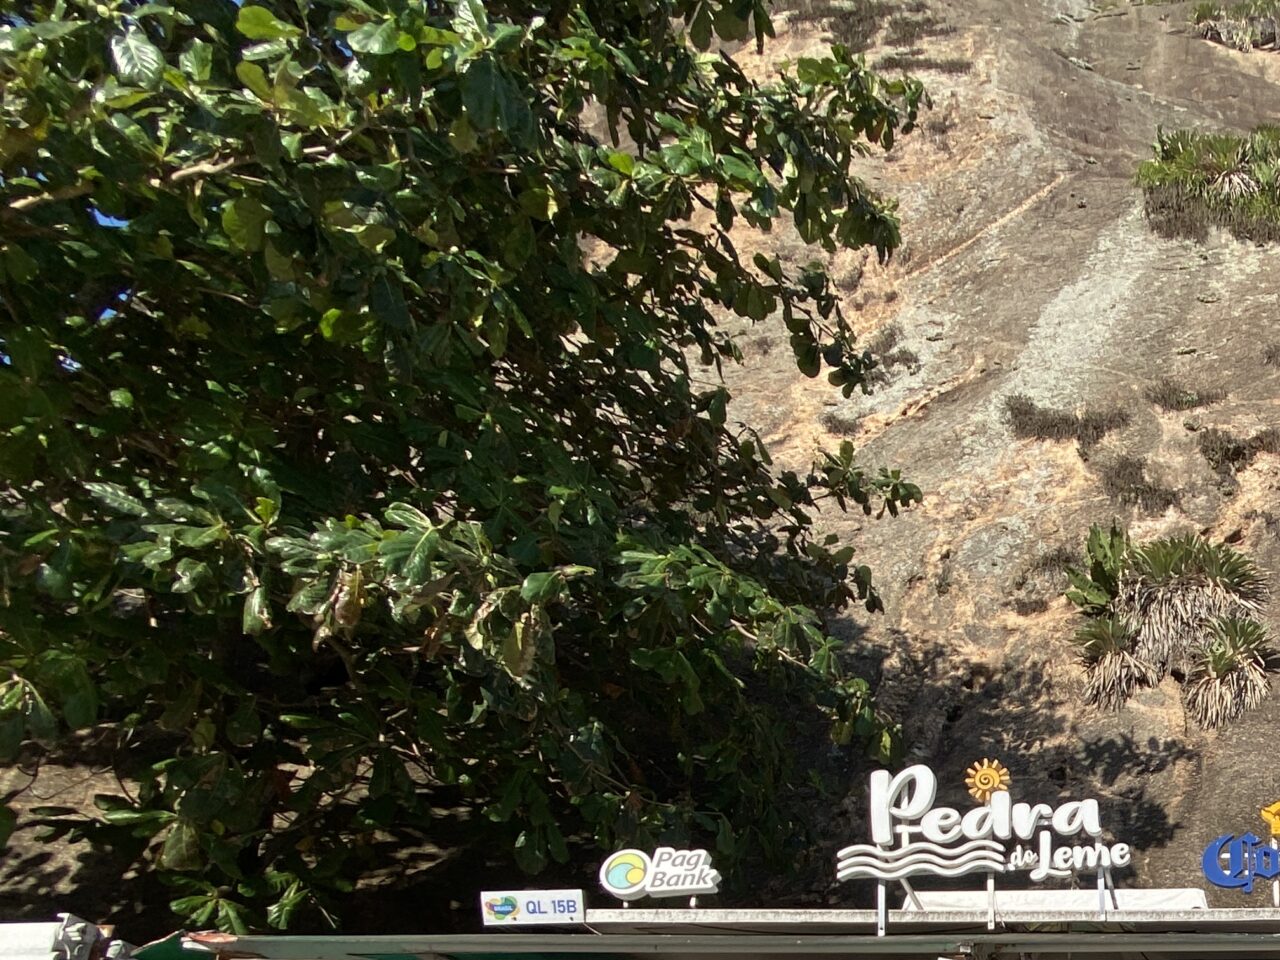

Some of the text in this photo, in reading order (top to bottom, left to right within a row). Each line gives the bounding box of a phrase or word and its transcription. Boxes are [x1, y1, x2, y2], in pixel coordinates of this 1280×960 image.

[869, 764, 1102, 846] Pedra
[656, 851, 702, 871] Pag
[1009, 830, 1131, 882] do Leme
[651, 868, 711, 888] Bank
[526, 900, 577, 914] QL 15B
